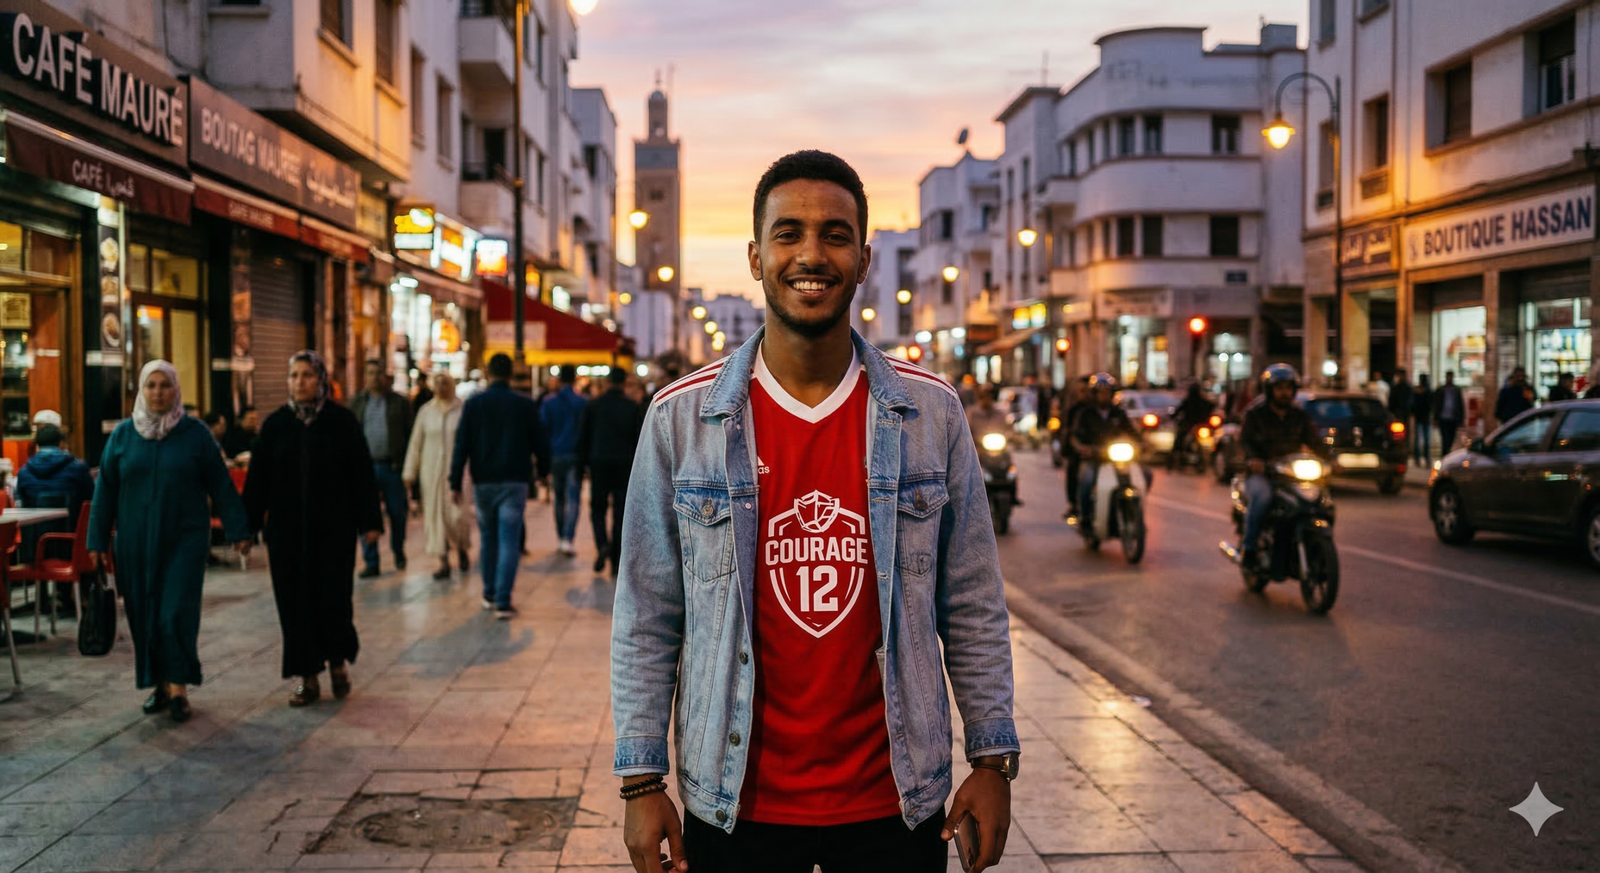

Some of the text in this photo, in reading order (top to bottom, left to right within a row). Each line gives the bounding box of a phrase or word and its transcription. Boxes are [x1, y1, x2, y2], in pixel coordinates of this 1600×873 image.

[13, 13, 183, 146] CAFÉ MAURÉ
[1424, 214, 1505, 256] BOUTIQUE
[1511, 196, 1592, 240] HASSAN
[765, 537, 868, 566] COURAGE
[796, 565, 838, 612] 12
